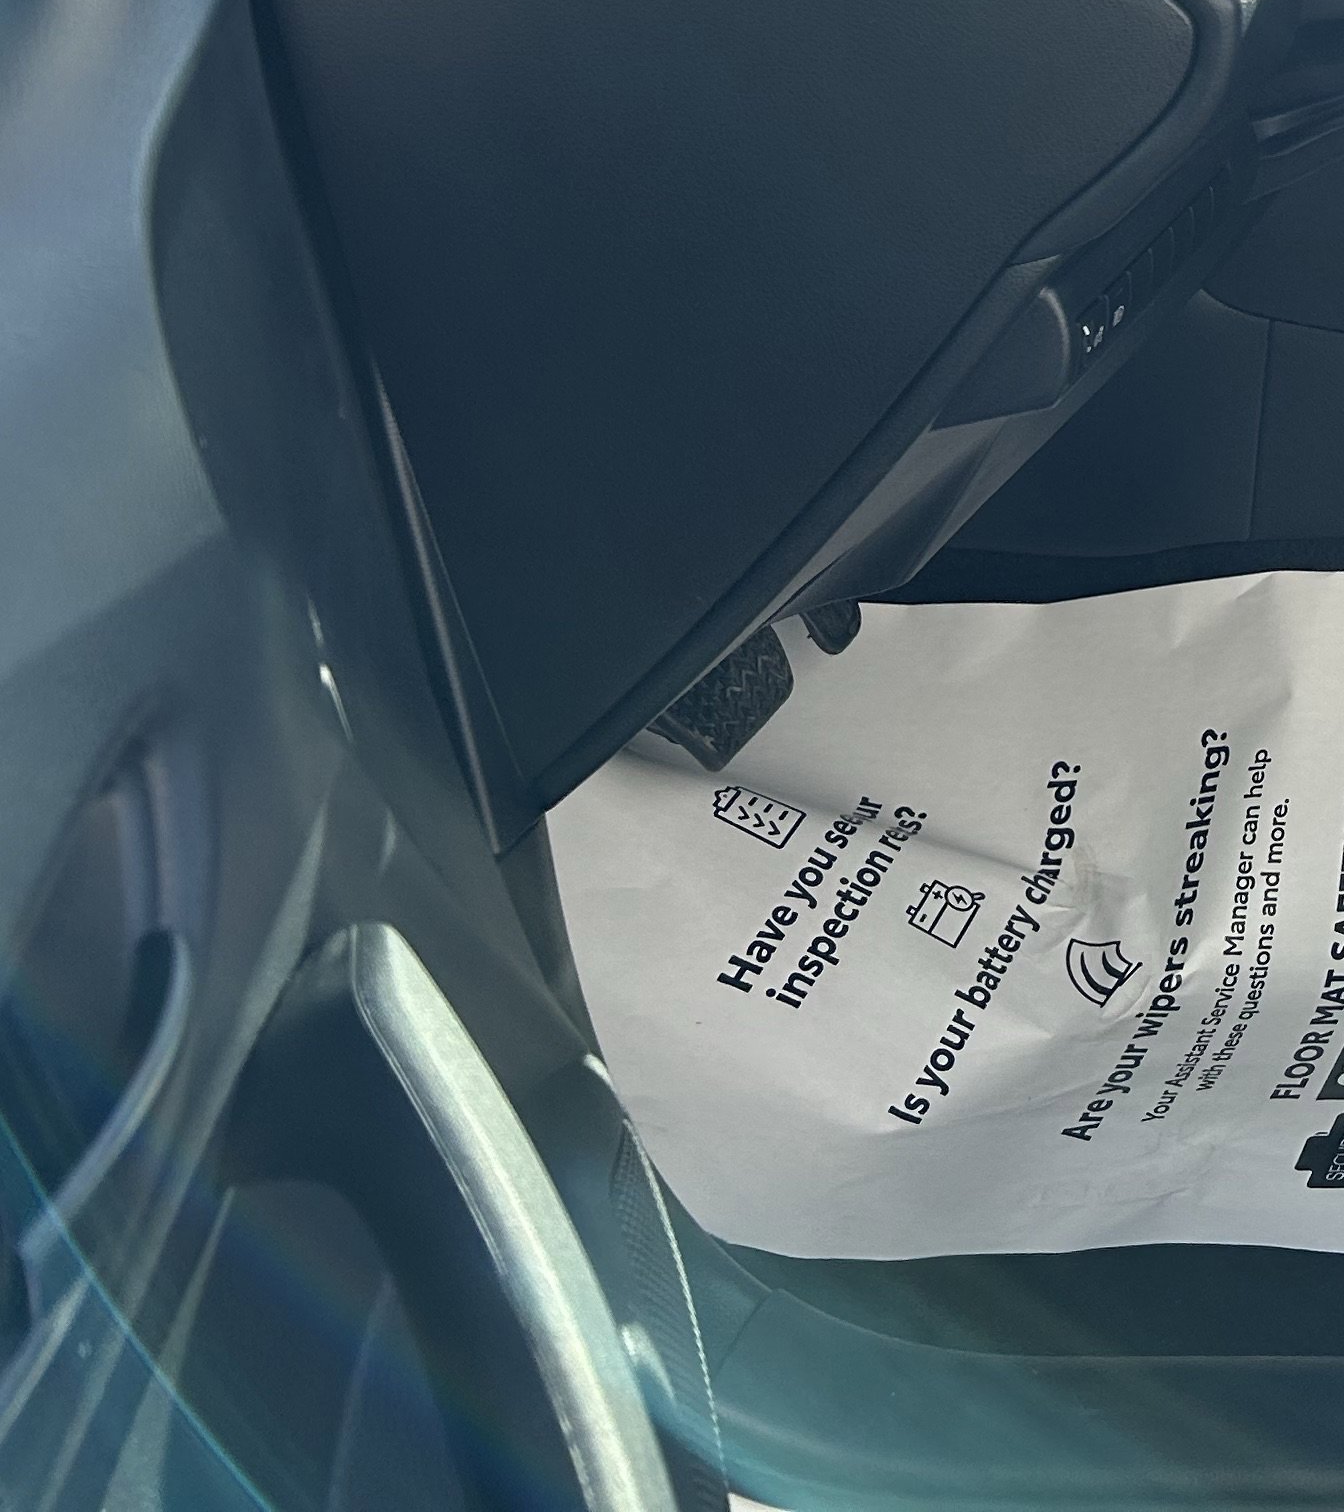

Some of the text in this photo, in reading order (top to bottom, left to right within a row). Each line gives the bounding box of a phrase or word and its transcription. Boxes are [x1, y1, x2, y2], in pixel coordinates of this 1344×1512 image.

[717, 905, 799, 993] Have
[784, 847, 838, 909] you
[766, 850, 894, 1009] inspection
[888, 760, 1081, 1124] Is your battery charged?
[1061, 728, 1230, 1141] Are your wipers streaking?
[1141, 749, 1272, 1124] Your Assistant Service Manager can help
[1196, 797, 1291, 1093] with these questions and more.
[1270, 1030, 1334, 1100] FLOOR
